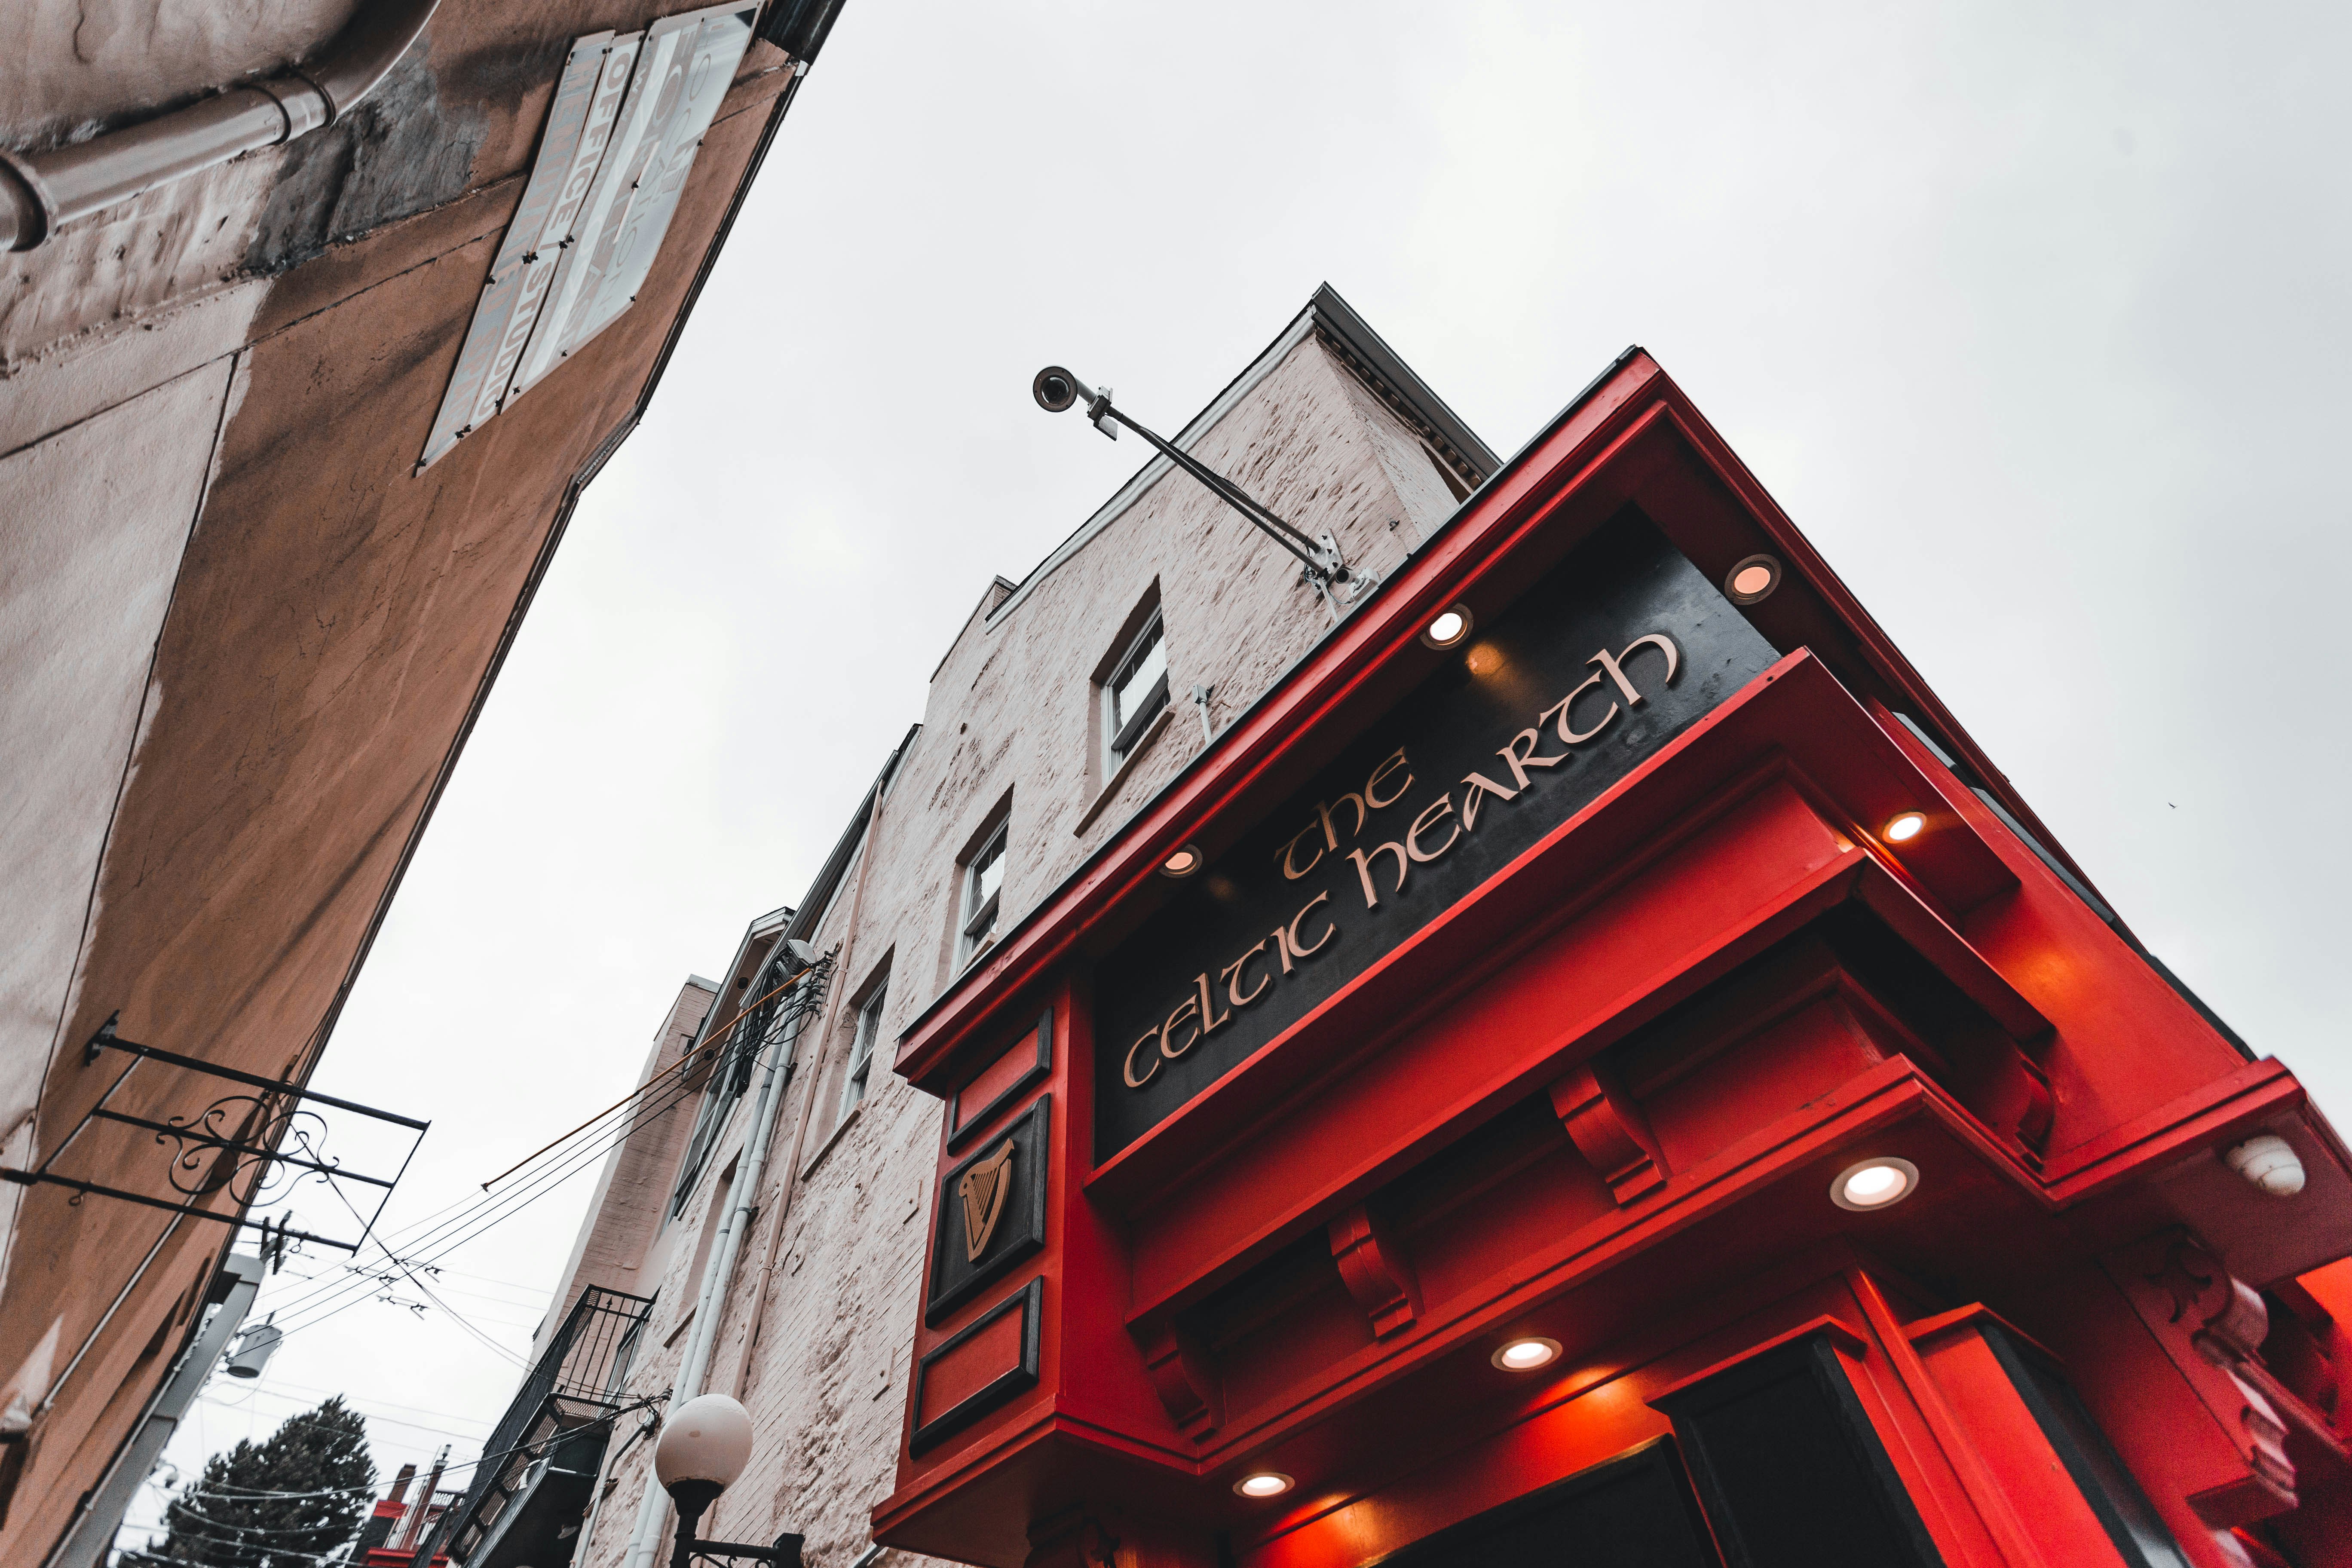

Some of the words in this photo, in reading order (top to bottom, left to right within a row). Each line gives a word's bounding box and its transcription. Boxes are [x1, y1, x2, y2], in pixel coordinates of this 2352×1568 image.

[483, 58, 597, 312] RENOVATED
[550, 52, 631, 230] OFFICE
[627, 22, 701, 174] FOR
[479, 262, 551, 417] STUDIO
[547, 190, 632, 367] LEASE
[431, 325, 498, 453] SPACE
[1123, 889, 1338, 1090] CELTIC
